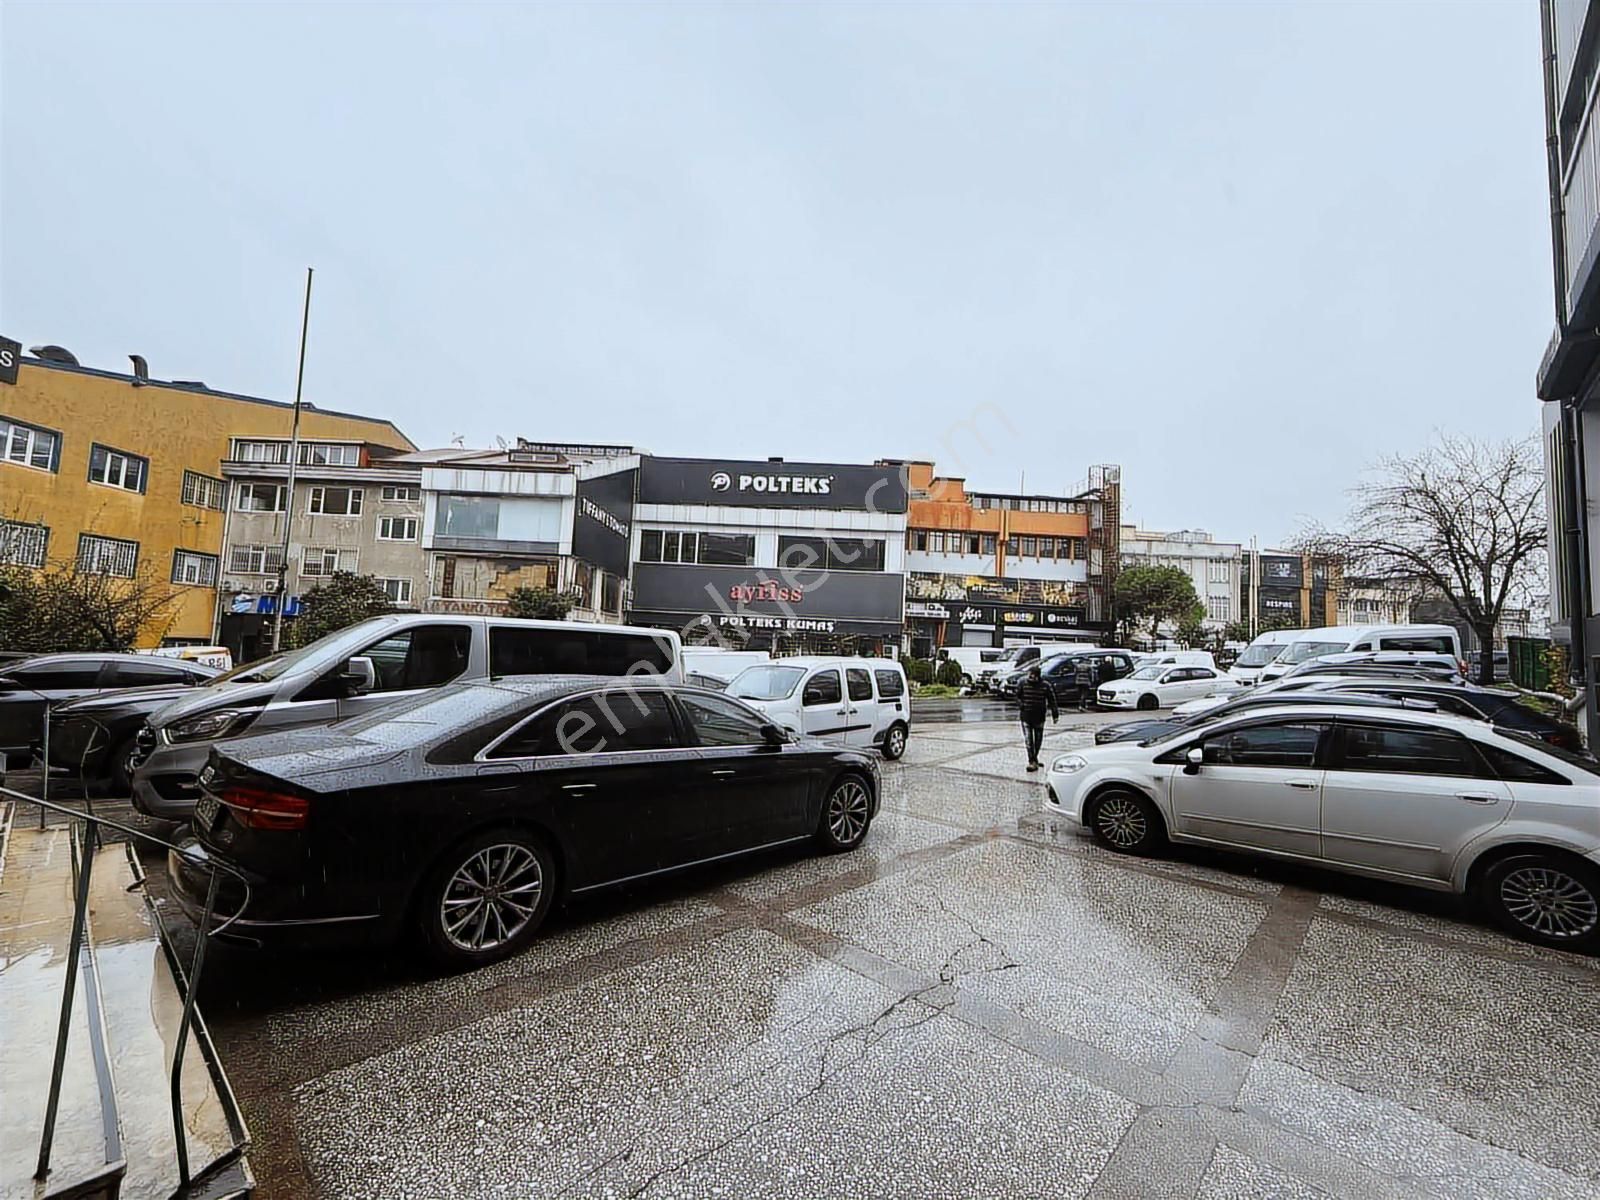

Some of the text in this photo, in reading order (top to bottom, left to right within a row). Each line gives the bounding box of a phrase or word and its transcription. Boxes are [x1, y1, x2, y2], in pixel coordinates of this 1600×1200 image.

[739, 475, 830, 494] POLTEKS
[720, 616, 835, 633] POLTEKS KUMAŞ
